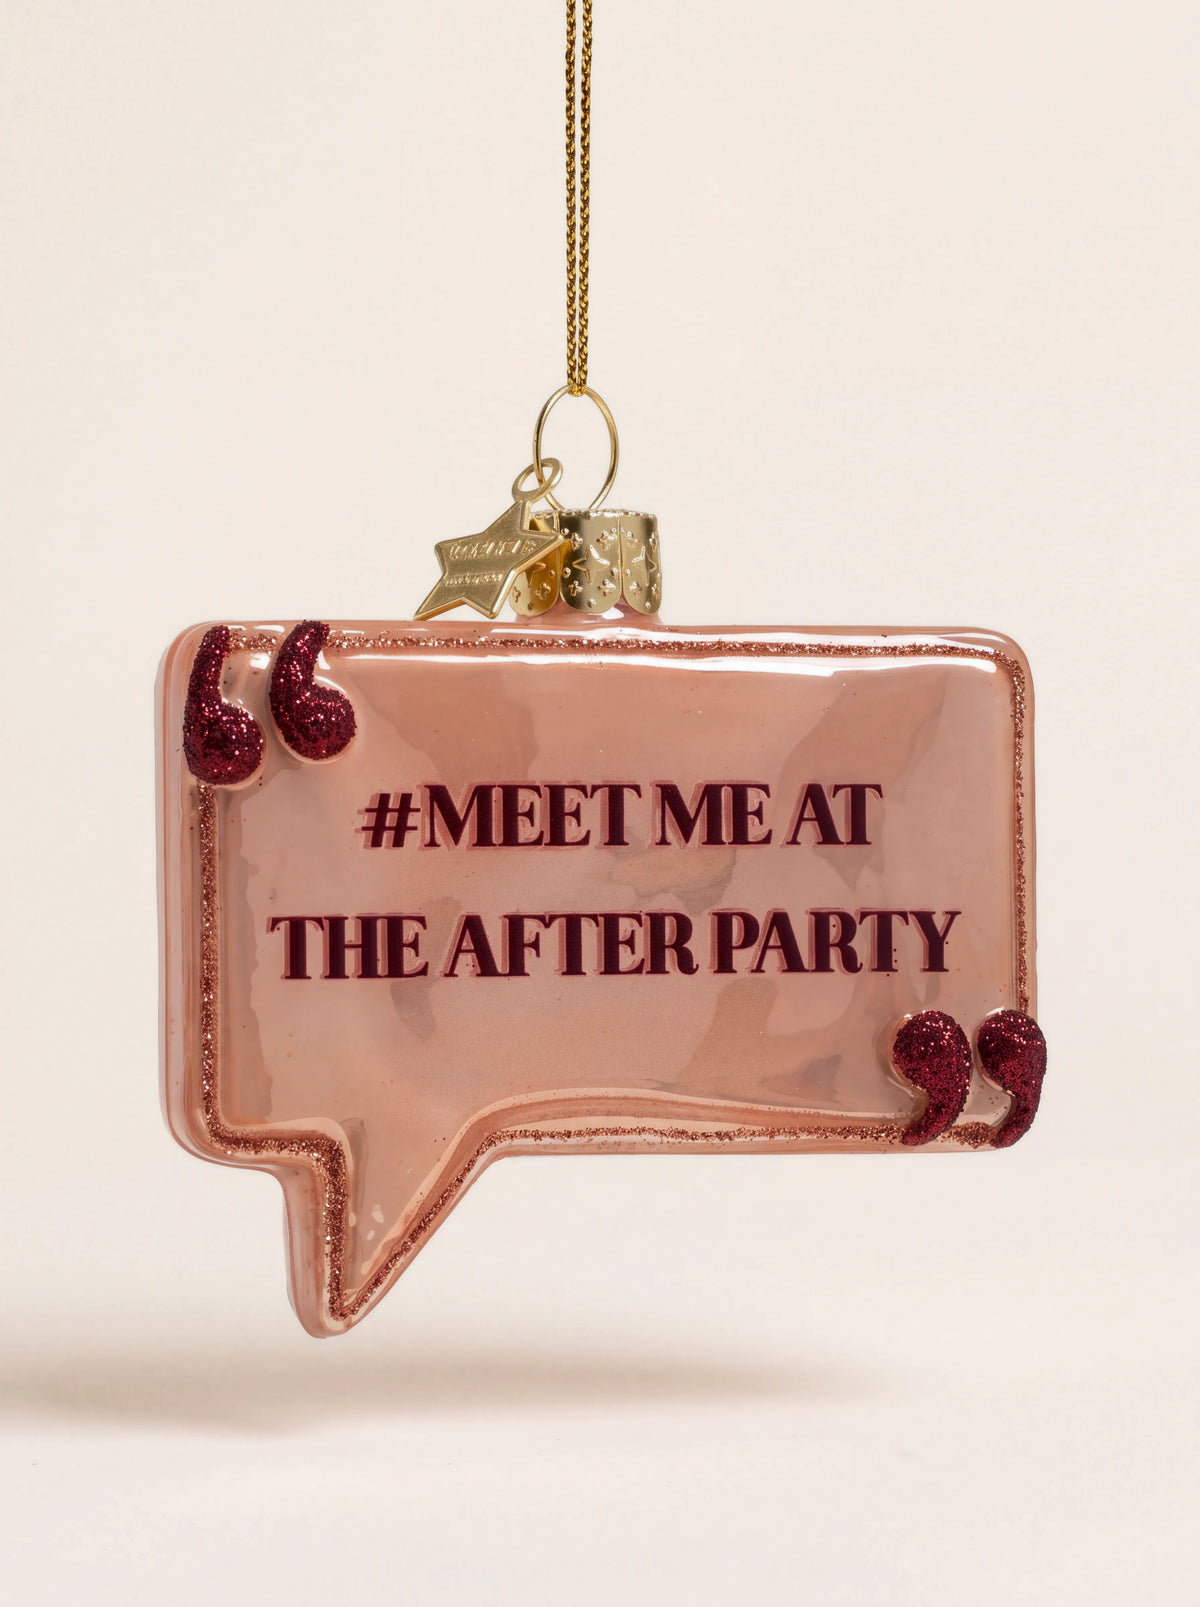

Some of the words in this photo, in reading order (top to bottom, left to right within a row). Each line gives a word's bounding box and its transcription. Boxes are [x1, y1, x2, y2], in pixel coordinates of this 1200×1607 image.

[361, 783, 641, 848] #MEET
[655, 783, 772, 846] ME
[784, 783, 883, 845] AT
[270, 914, 430, 980] THE
[442, 910, 699, 978] AFTER
[711, 907, 961, 976] PARTY
